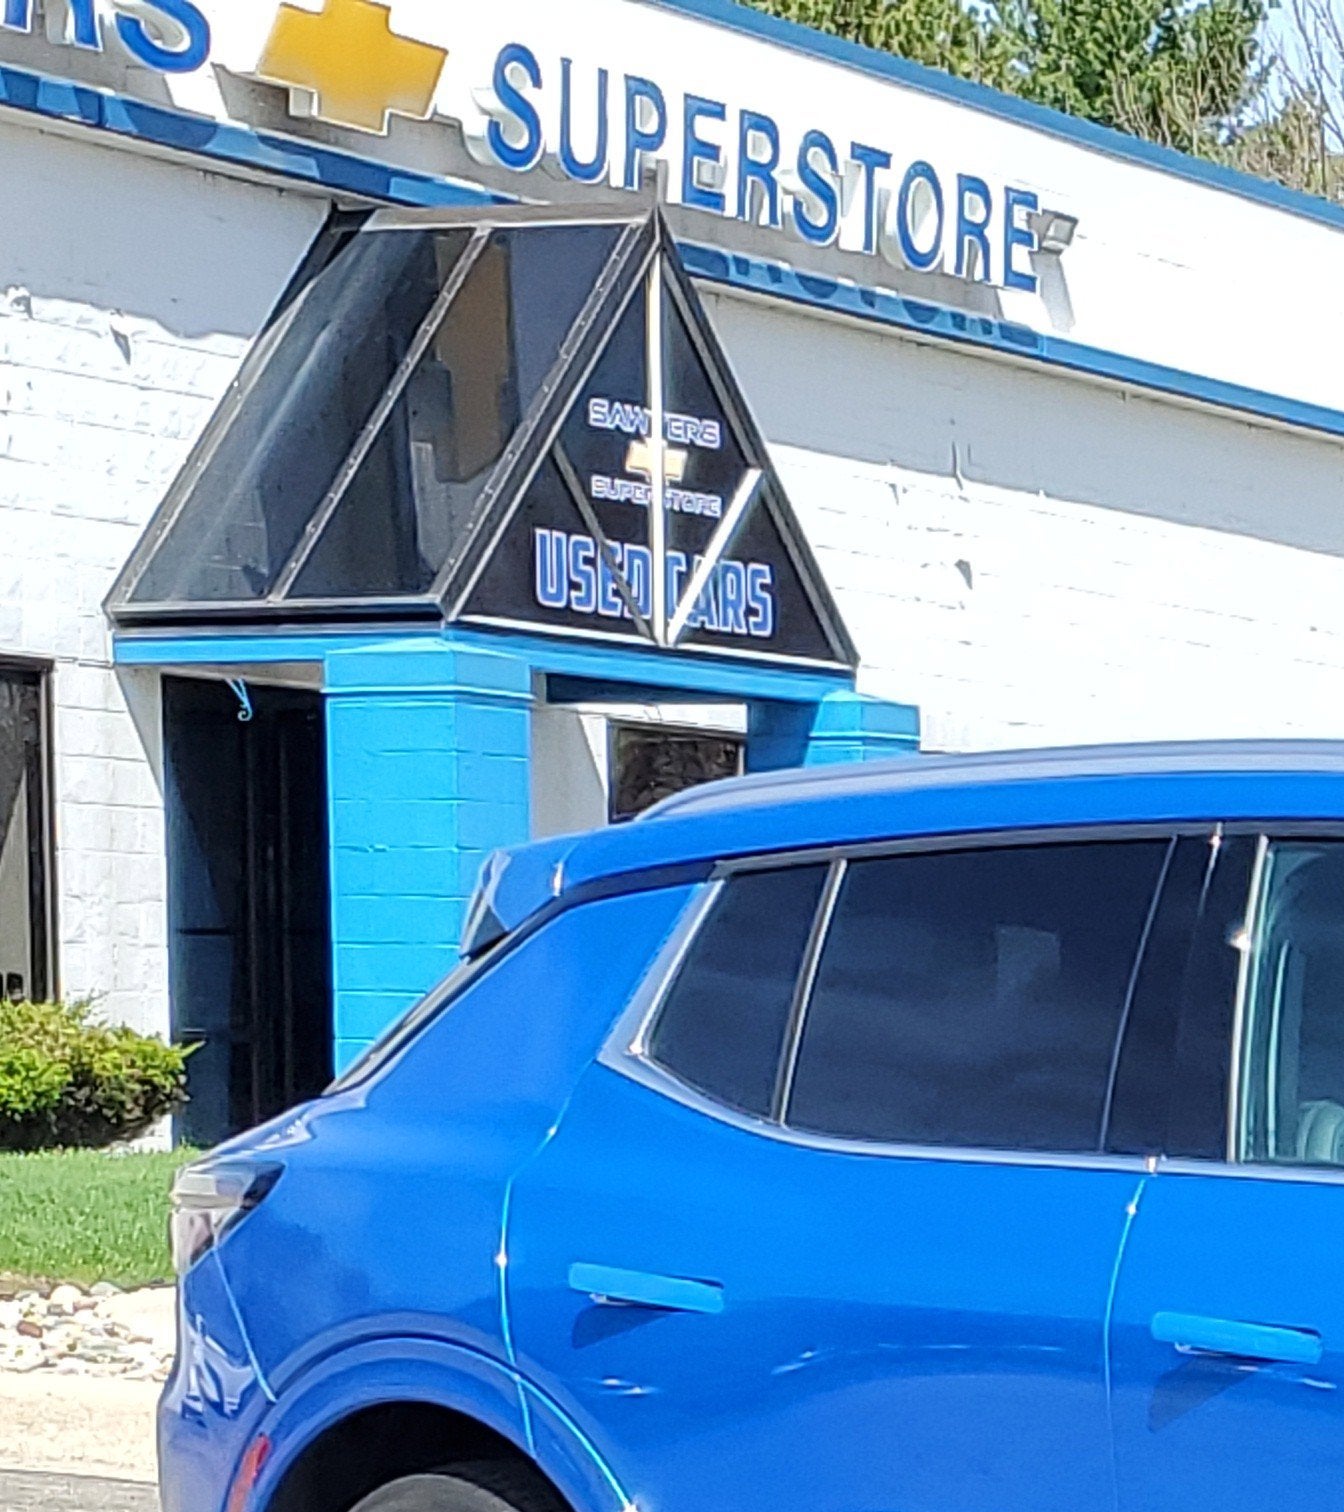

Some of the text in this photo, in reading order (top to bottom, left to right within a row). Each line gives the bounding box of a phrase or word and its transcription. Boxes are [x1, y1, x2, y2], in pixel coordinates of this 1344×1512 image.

[487, 42, 1039, 294] SUPERSTORE
[589, 397, 720, 449] SAWERS
[534, 527, 652, 620] USED
